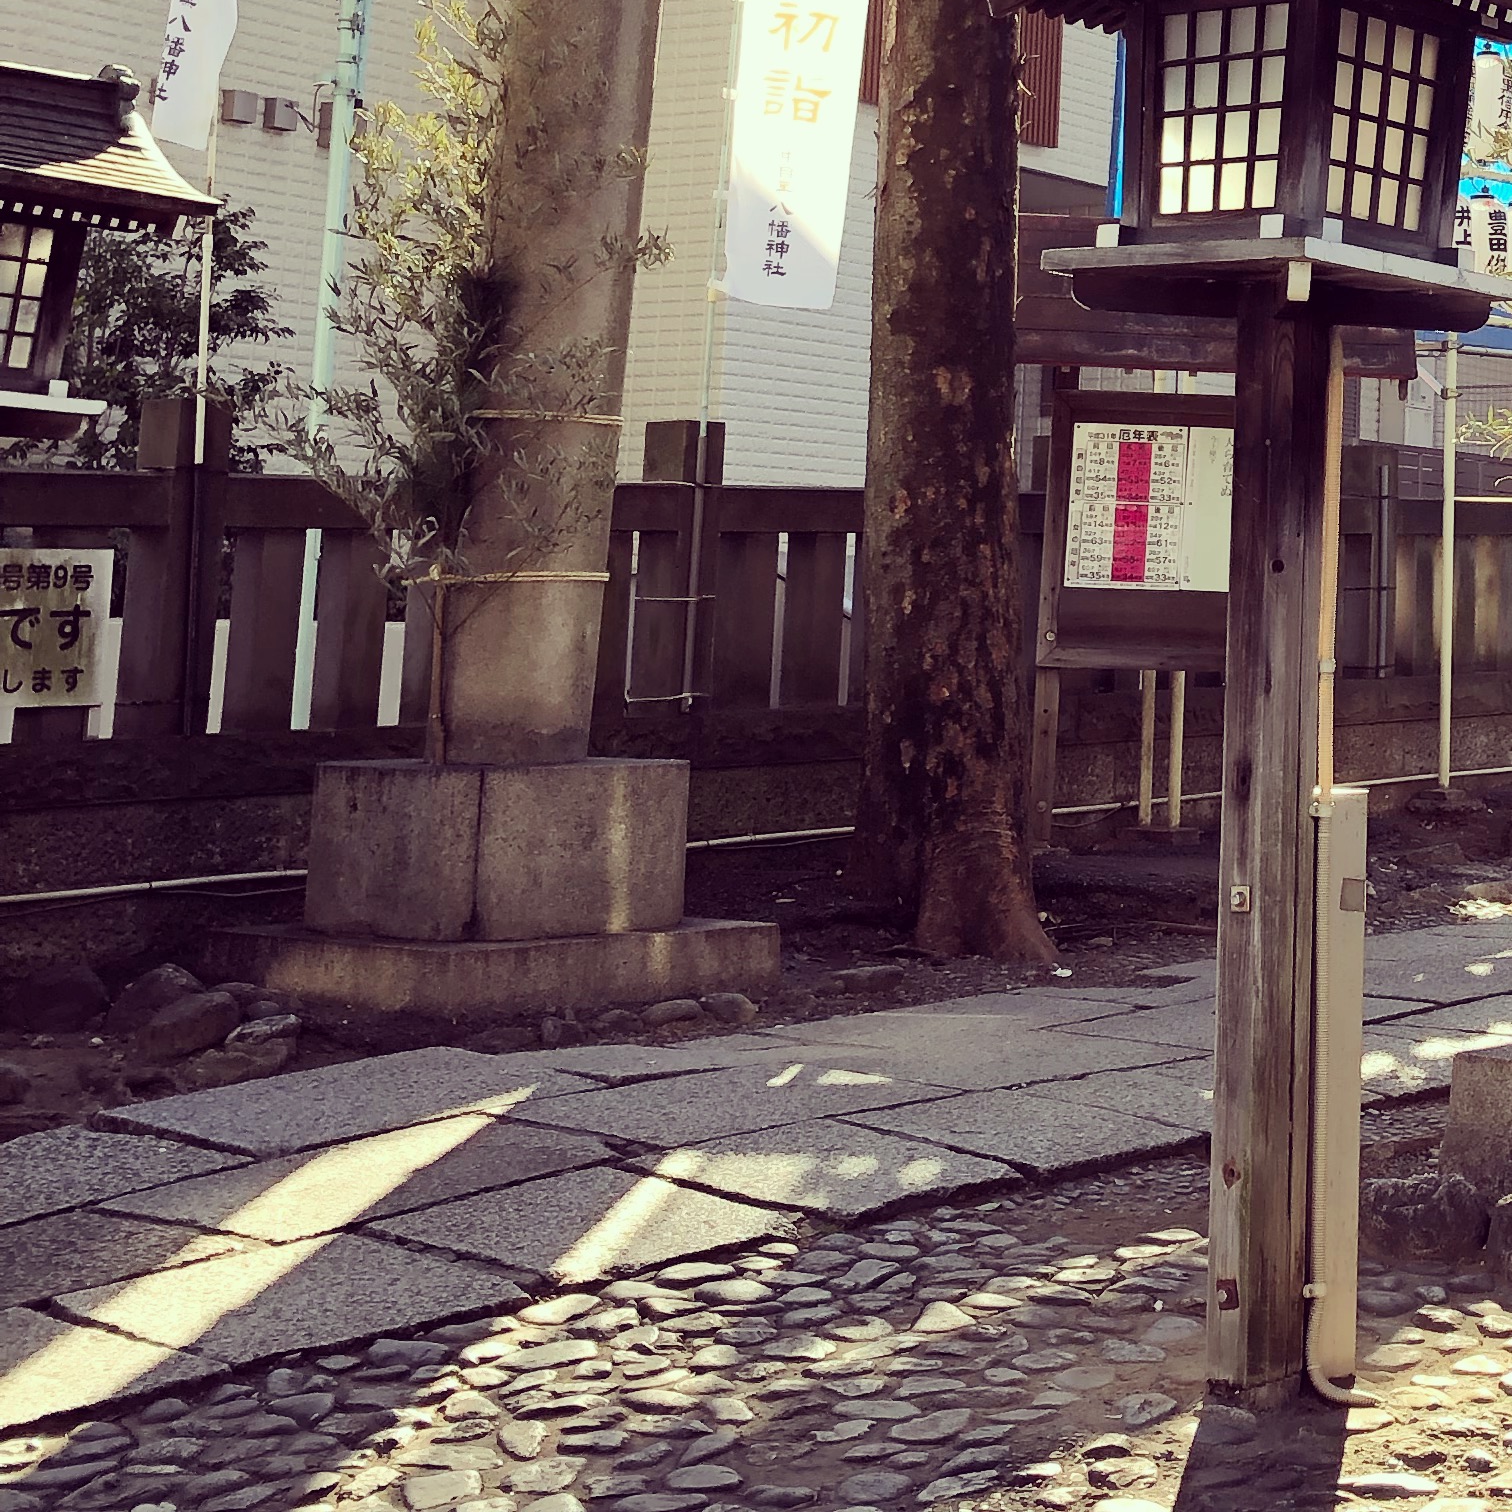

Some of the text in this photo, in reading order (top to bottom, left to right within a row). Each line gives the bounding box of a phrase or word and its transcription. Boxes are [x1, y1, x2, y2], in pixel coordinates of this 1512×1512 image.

[762, 0, 841, 125] 初詣
[0, 563, 94, 591] 号第9号
[0, 603, 91, 651] です
[2, 666, 84, 694] します
